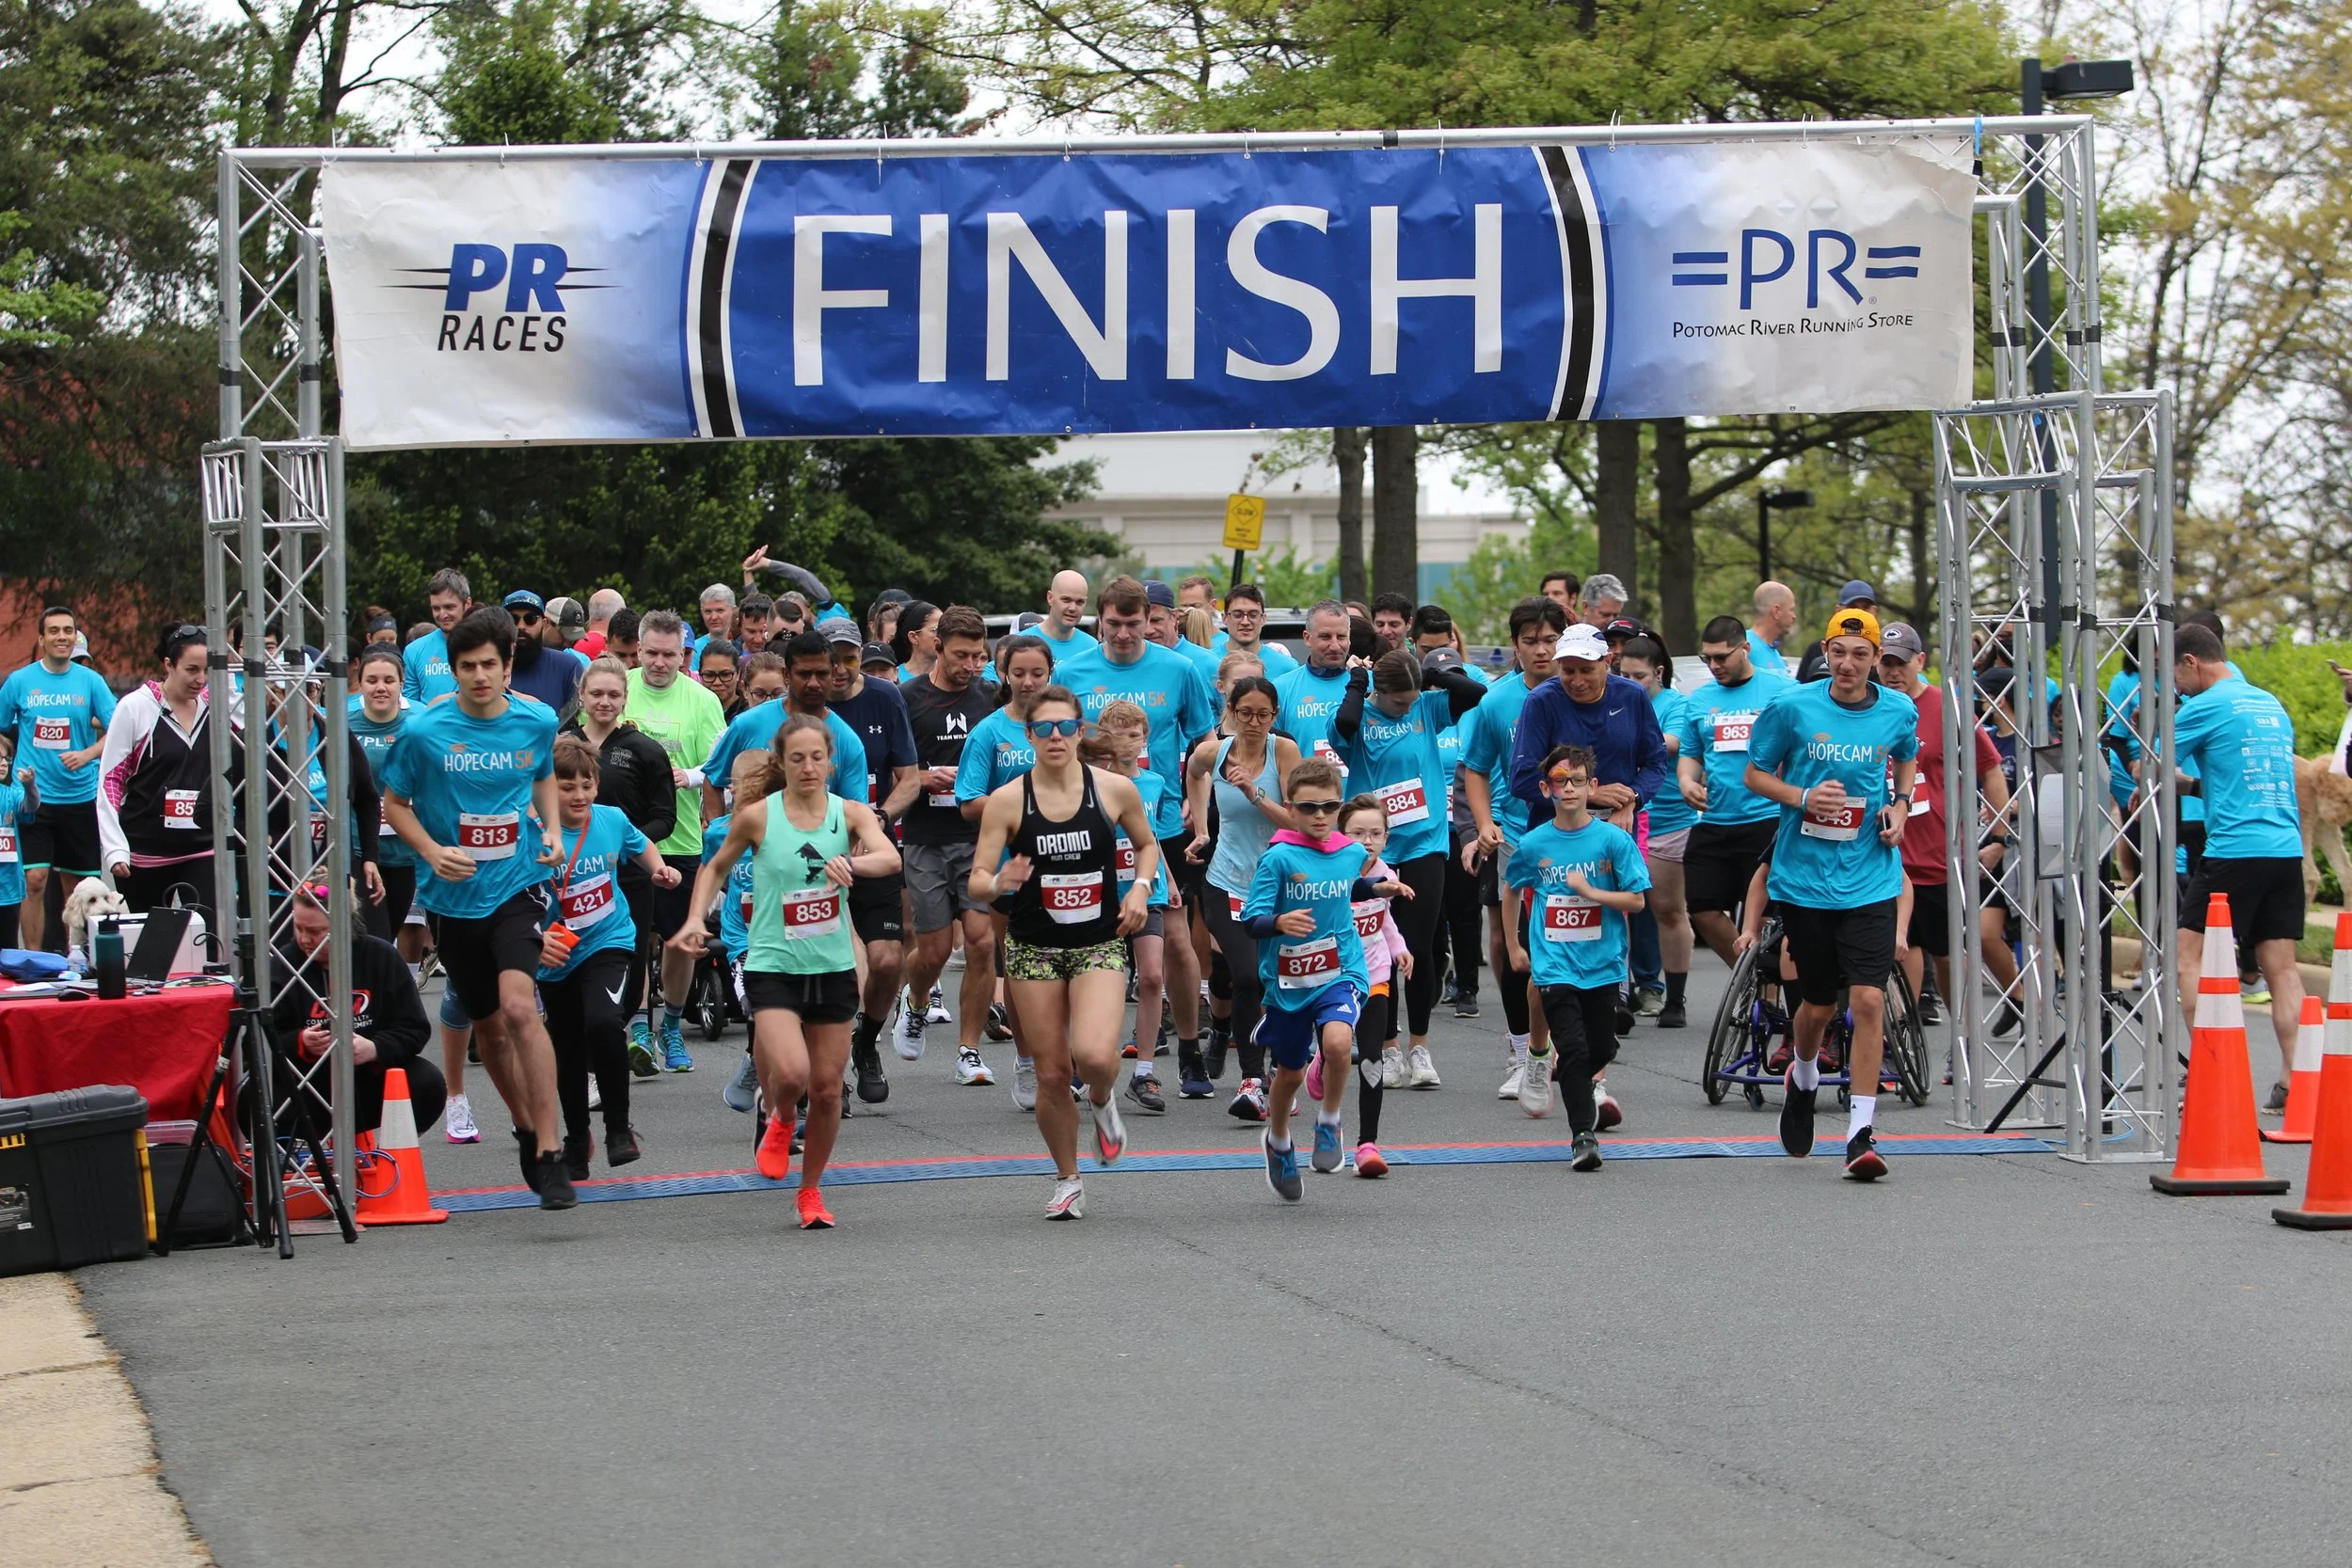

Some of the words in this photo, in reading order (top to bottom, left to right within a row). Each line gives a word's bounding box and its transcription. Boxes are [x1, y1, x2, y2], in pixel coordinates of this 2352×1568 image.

[444, 243, 568, 312] PR
[793, 203, 1502, 387] FINISH
[1867, 311, 1915, 328] STORE
[437, 314, 567, 352] RACES
[26, 693, 72, 708] HOPECAM
[72, 695, 86, 706] 5K
[1148, 691, 1168, 706] 5K
[40, 726, 64, 739] 820
[1363, 722, 1413, 741] HOPECAM
[1722, 725, 1749, 740] 963
[444, 752, 513, 772] HOPECAM
[515, 750, 535, 768] 5K
[1807, 742, 1872, 763] HOPECAM
[174, 800, 197, 816] 85
[1386, 792, 1418, 813] 884
[471, 827, 509, 846] 813
[1036, 830, 1092, 856] DROMO
[1064, 852, 1082, 861] CREW
[1054, 888, 1091, 908] 852
[1285, 879, 1349, 901] HOPECAM
[572, 889, 605, 913] 421
[795, 900, 833, 923] 853
[1555, 909, 1591, 927] 867
[1289, 953, 1327, 974] 872
